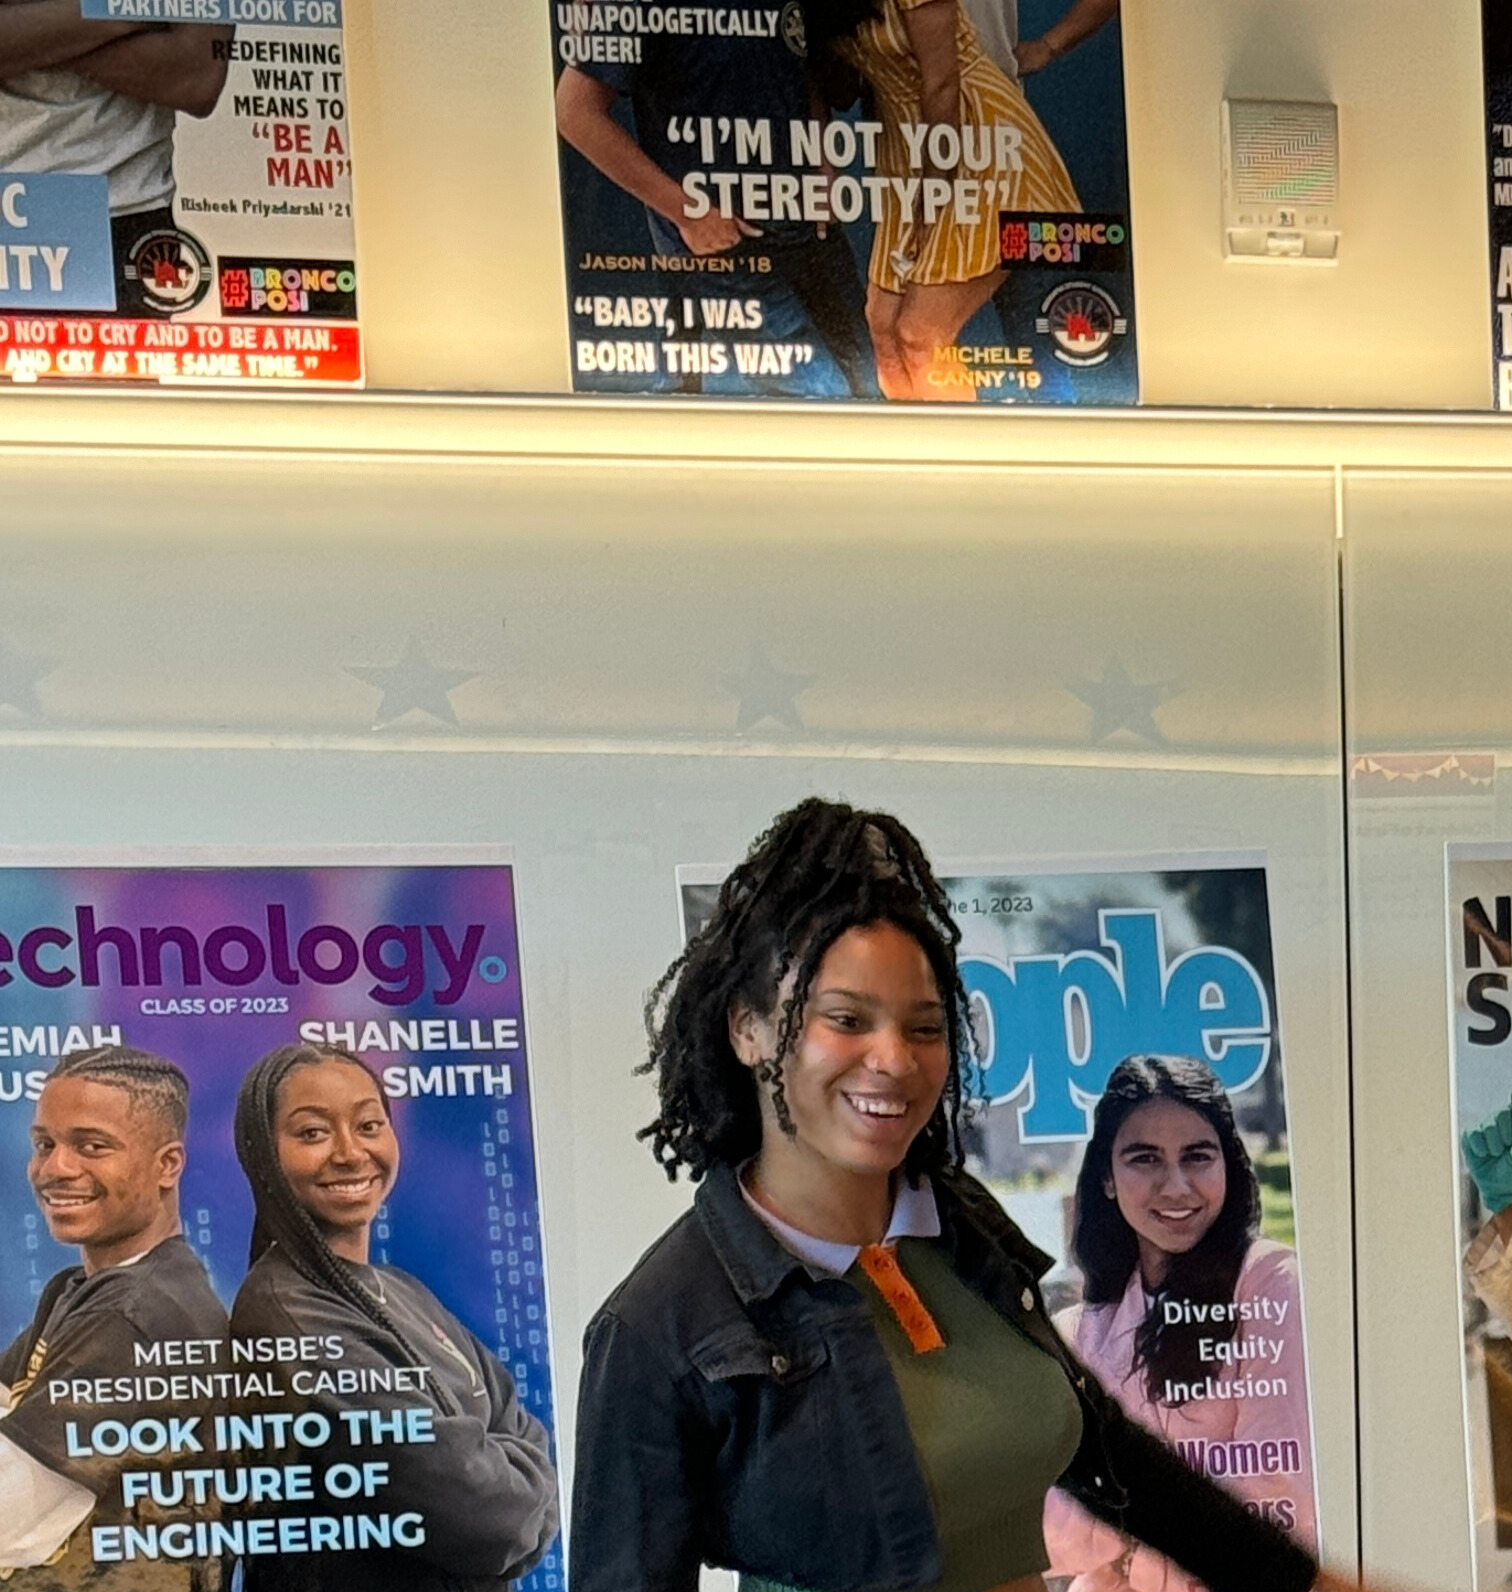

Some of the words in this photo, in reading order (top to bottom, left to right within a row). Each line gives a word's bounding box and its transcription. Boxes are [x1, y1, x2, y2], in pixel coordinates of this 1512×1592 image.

[557, 4, 779, 37] UNAPOLOGETICALLY
[212, 40, 341, 65] REDEFINING
[559, 35, 642, 65] QUEER!
[252, 69, 313, 92] WHAT
[322, 72, 342, 93] IT
[234, 96, 308, 118] MEANS
[316, 99, 344, 119] TO
[324, 126, 344, 155] A
[789, 122, 882, 169] NOT
[902, 124, 1023, 172] YOUR
[580, 253, 644, 271] JASON
[651, 254, 734, 273] NGUYEN
[684, 298, 693, 326] I
[700, 299, 762, 327] WAS
[15, 322, 57, 344] NOT
[65, 323, 93, 344] TO
[100, 325, 137, 345] CRY
[144, 326, 188, 347] AND
[195, 327, 222, 347] TO
[230, 328, 256, 349] BE
[264, 330, 278, 349] A
[284, 330, 337, 351] MAN.
[578, 342, 655, 373] BORN
[662, 342, 728, 375] THIS
[933, 346, 1033, 364] MICHELE
[928, 370, 1003, 388] CANNY
[990, 898, 1033, 913] 2023
[141, 999, 205, 1014] CLASS
[212, 999, 236, 1014] OF
[240, 998, 289, 1014] 2023
[300, 1019, 519, 1052] SHANELLE
[384, 1066, 512, 1097] SMITH
[1164, 1296, 1289, 1326] Diversity
[135, 1341, 222, 1367] MEET
[232, 1337, 344, 1363] NSBE'S
[1199, 1337, 1284, 1363] Equity
[49, 1375, 284, 1404] PRESIDENTIAL
[291, 1368, 430, 1396] CABINET
[1165, 1375, 1288, 1402] Inclusion
[67, 1419, 203, 1458] LOOK
[215, 1413, 330, 1451] INTO
[340, 1409, 436, 1445] THE
[121, 1465, 313, 1506] FUTURE
[325, 1463, 390, 1498] OF
[91, 1514, 426, 1561] ENGINEERING
